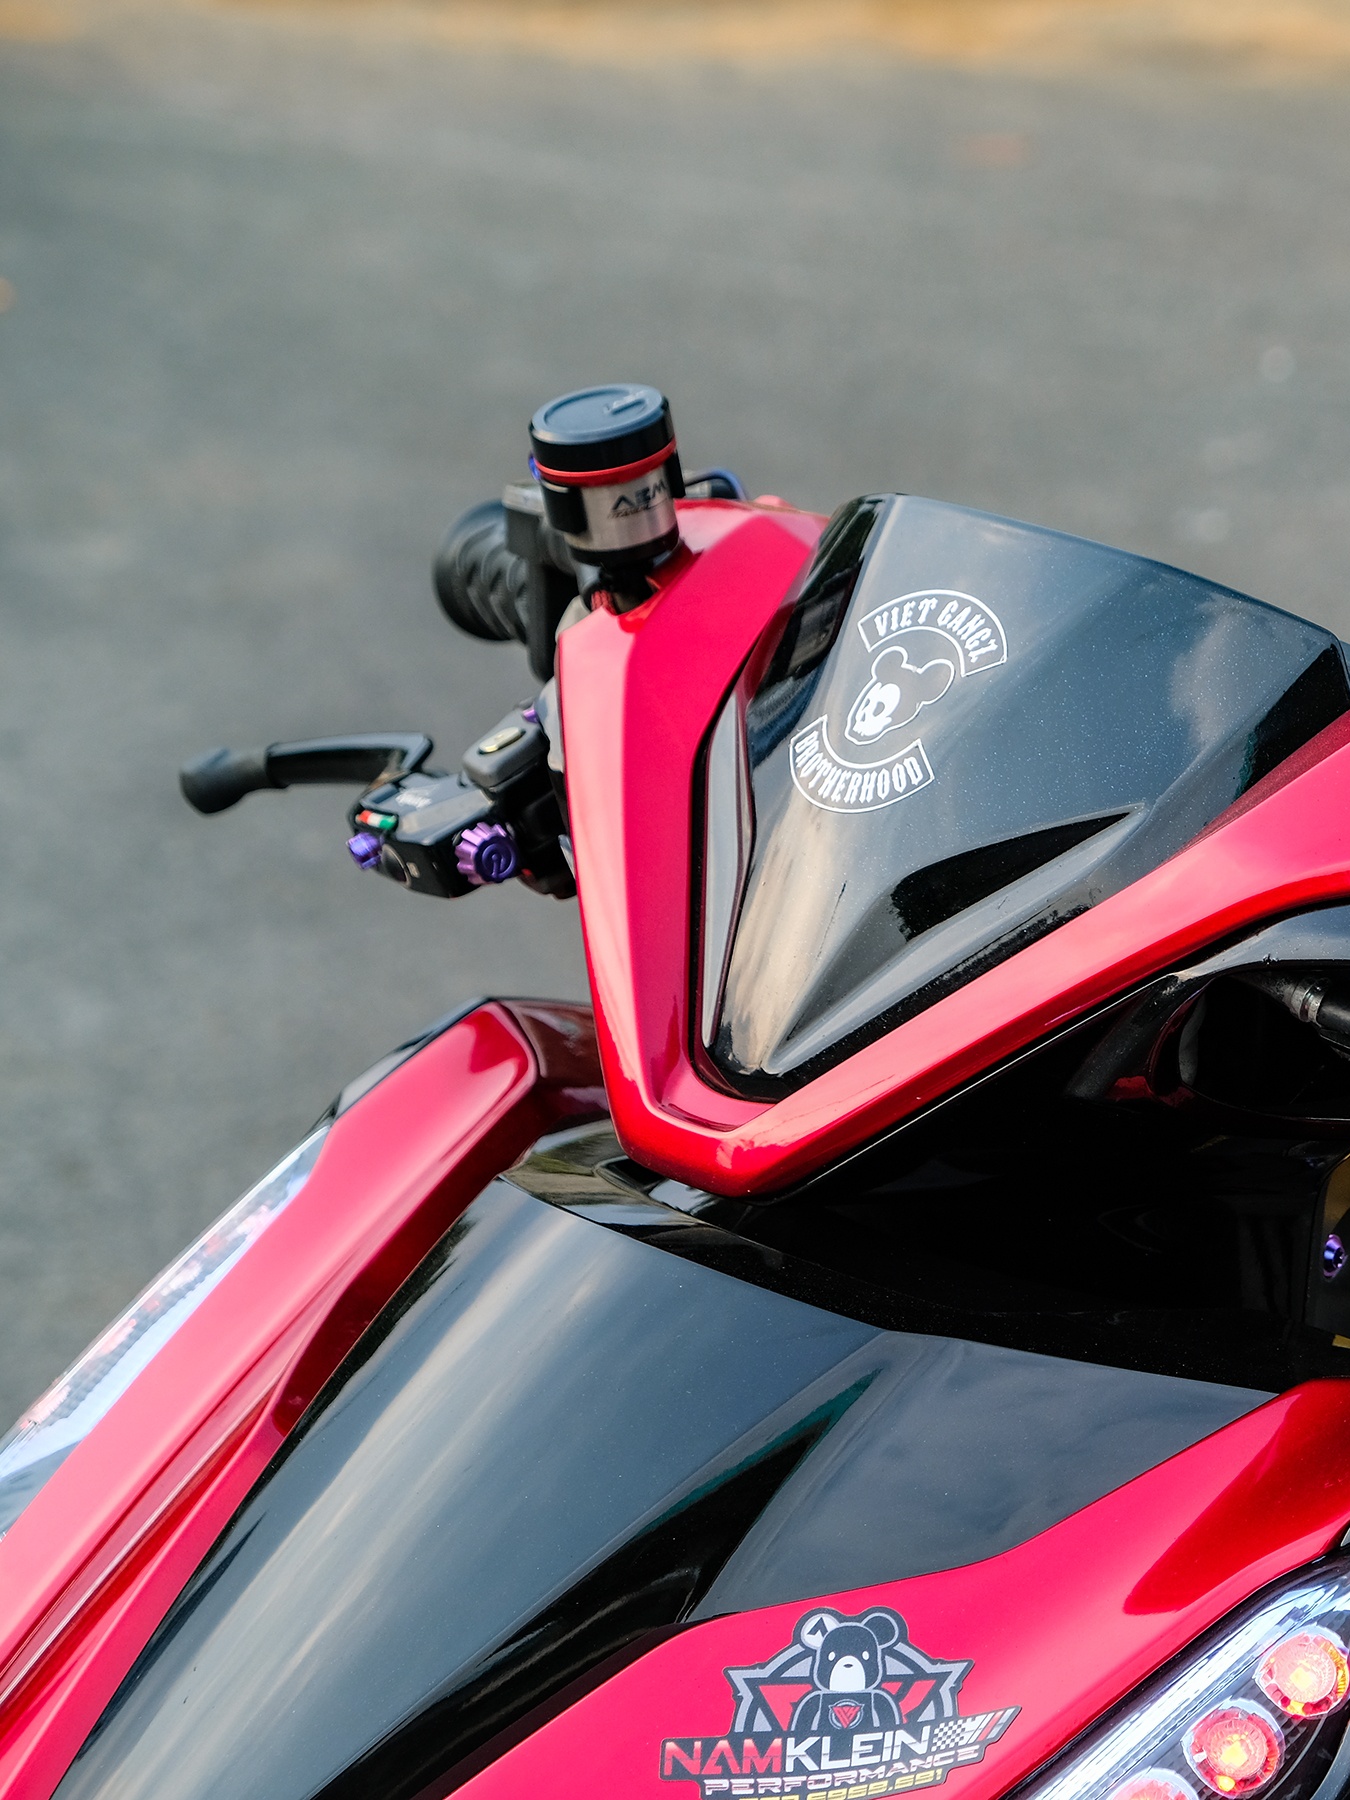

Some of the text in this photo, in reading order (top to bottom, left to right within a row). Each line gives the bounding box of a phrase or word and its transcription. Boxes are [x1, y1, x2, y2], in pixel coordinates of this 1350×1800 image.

[873, 597, 938, 637] VIET
[795, 730, 924, 804] BROTHERHOOD
[703, 1744, 980, 1796] PERFORMANCE
